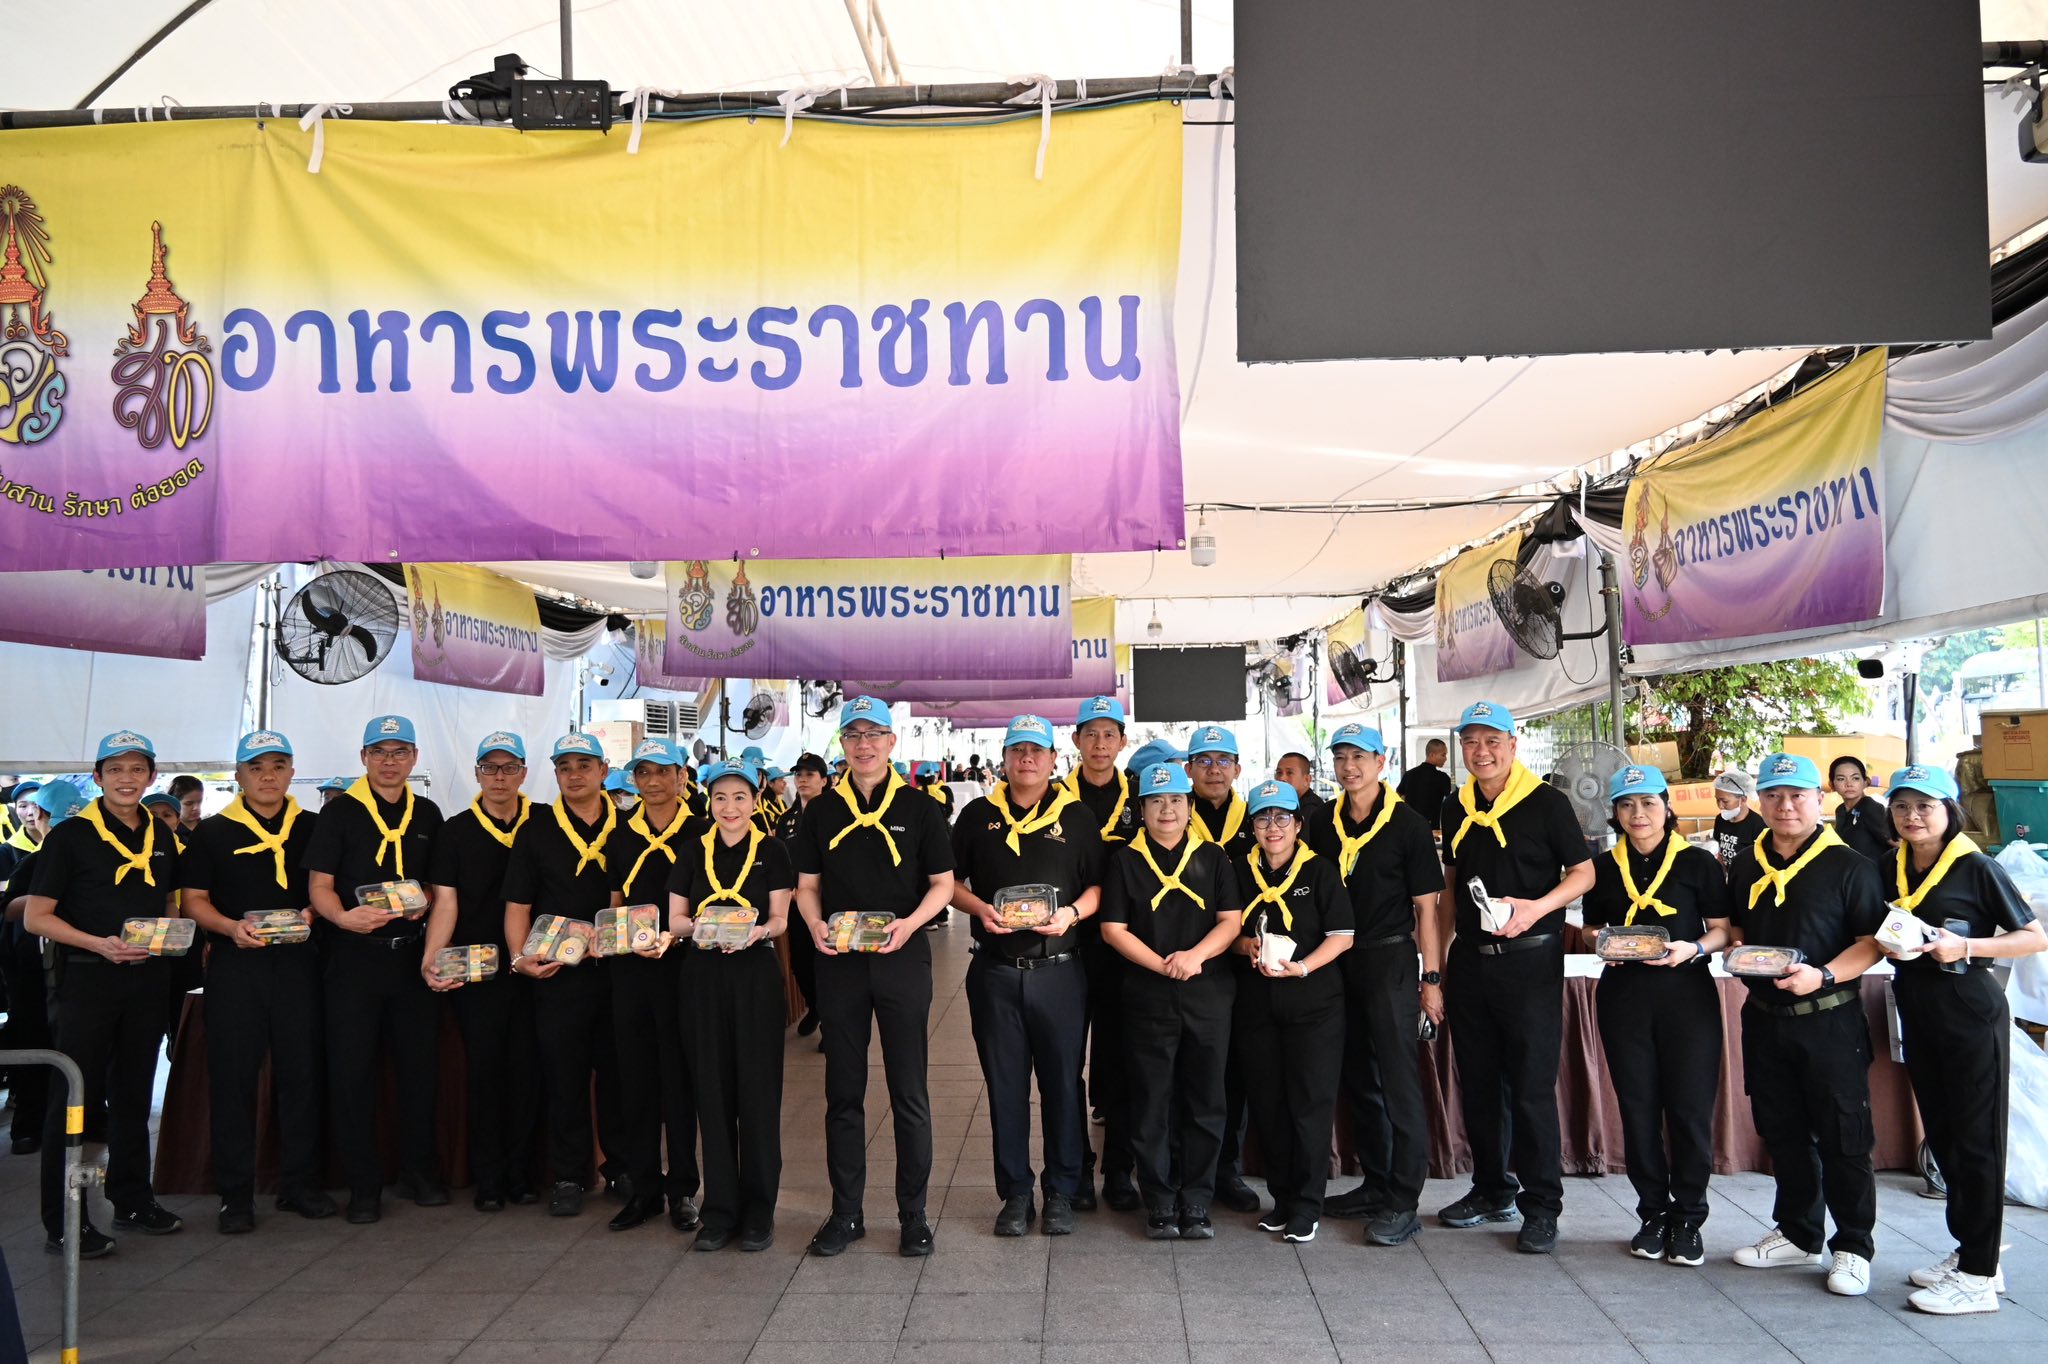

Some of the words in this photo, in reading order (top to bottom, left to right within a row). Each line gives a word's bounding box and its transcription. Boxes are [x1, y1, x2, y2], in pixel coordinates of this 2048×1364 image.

[219, 295, 1142, 394] อาหารพระราชทาน
[63, 491, 122, 517] รักษา
[130, 457, 204, 509] ต่อยอด
[760, 584, 1060, 618] อาหารพระราชทาน
[445, 611, 538, 653] อาหารพระราชทาน
